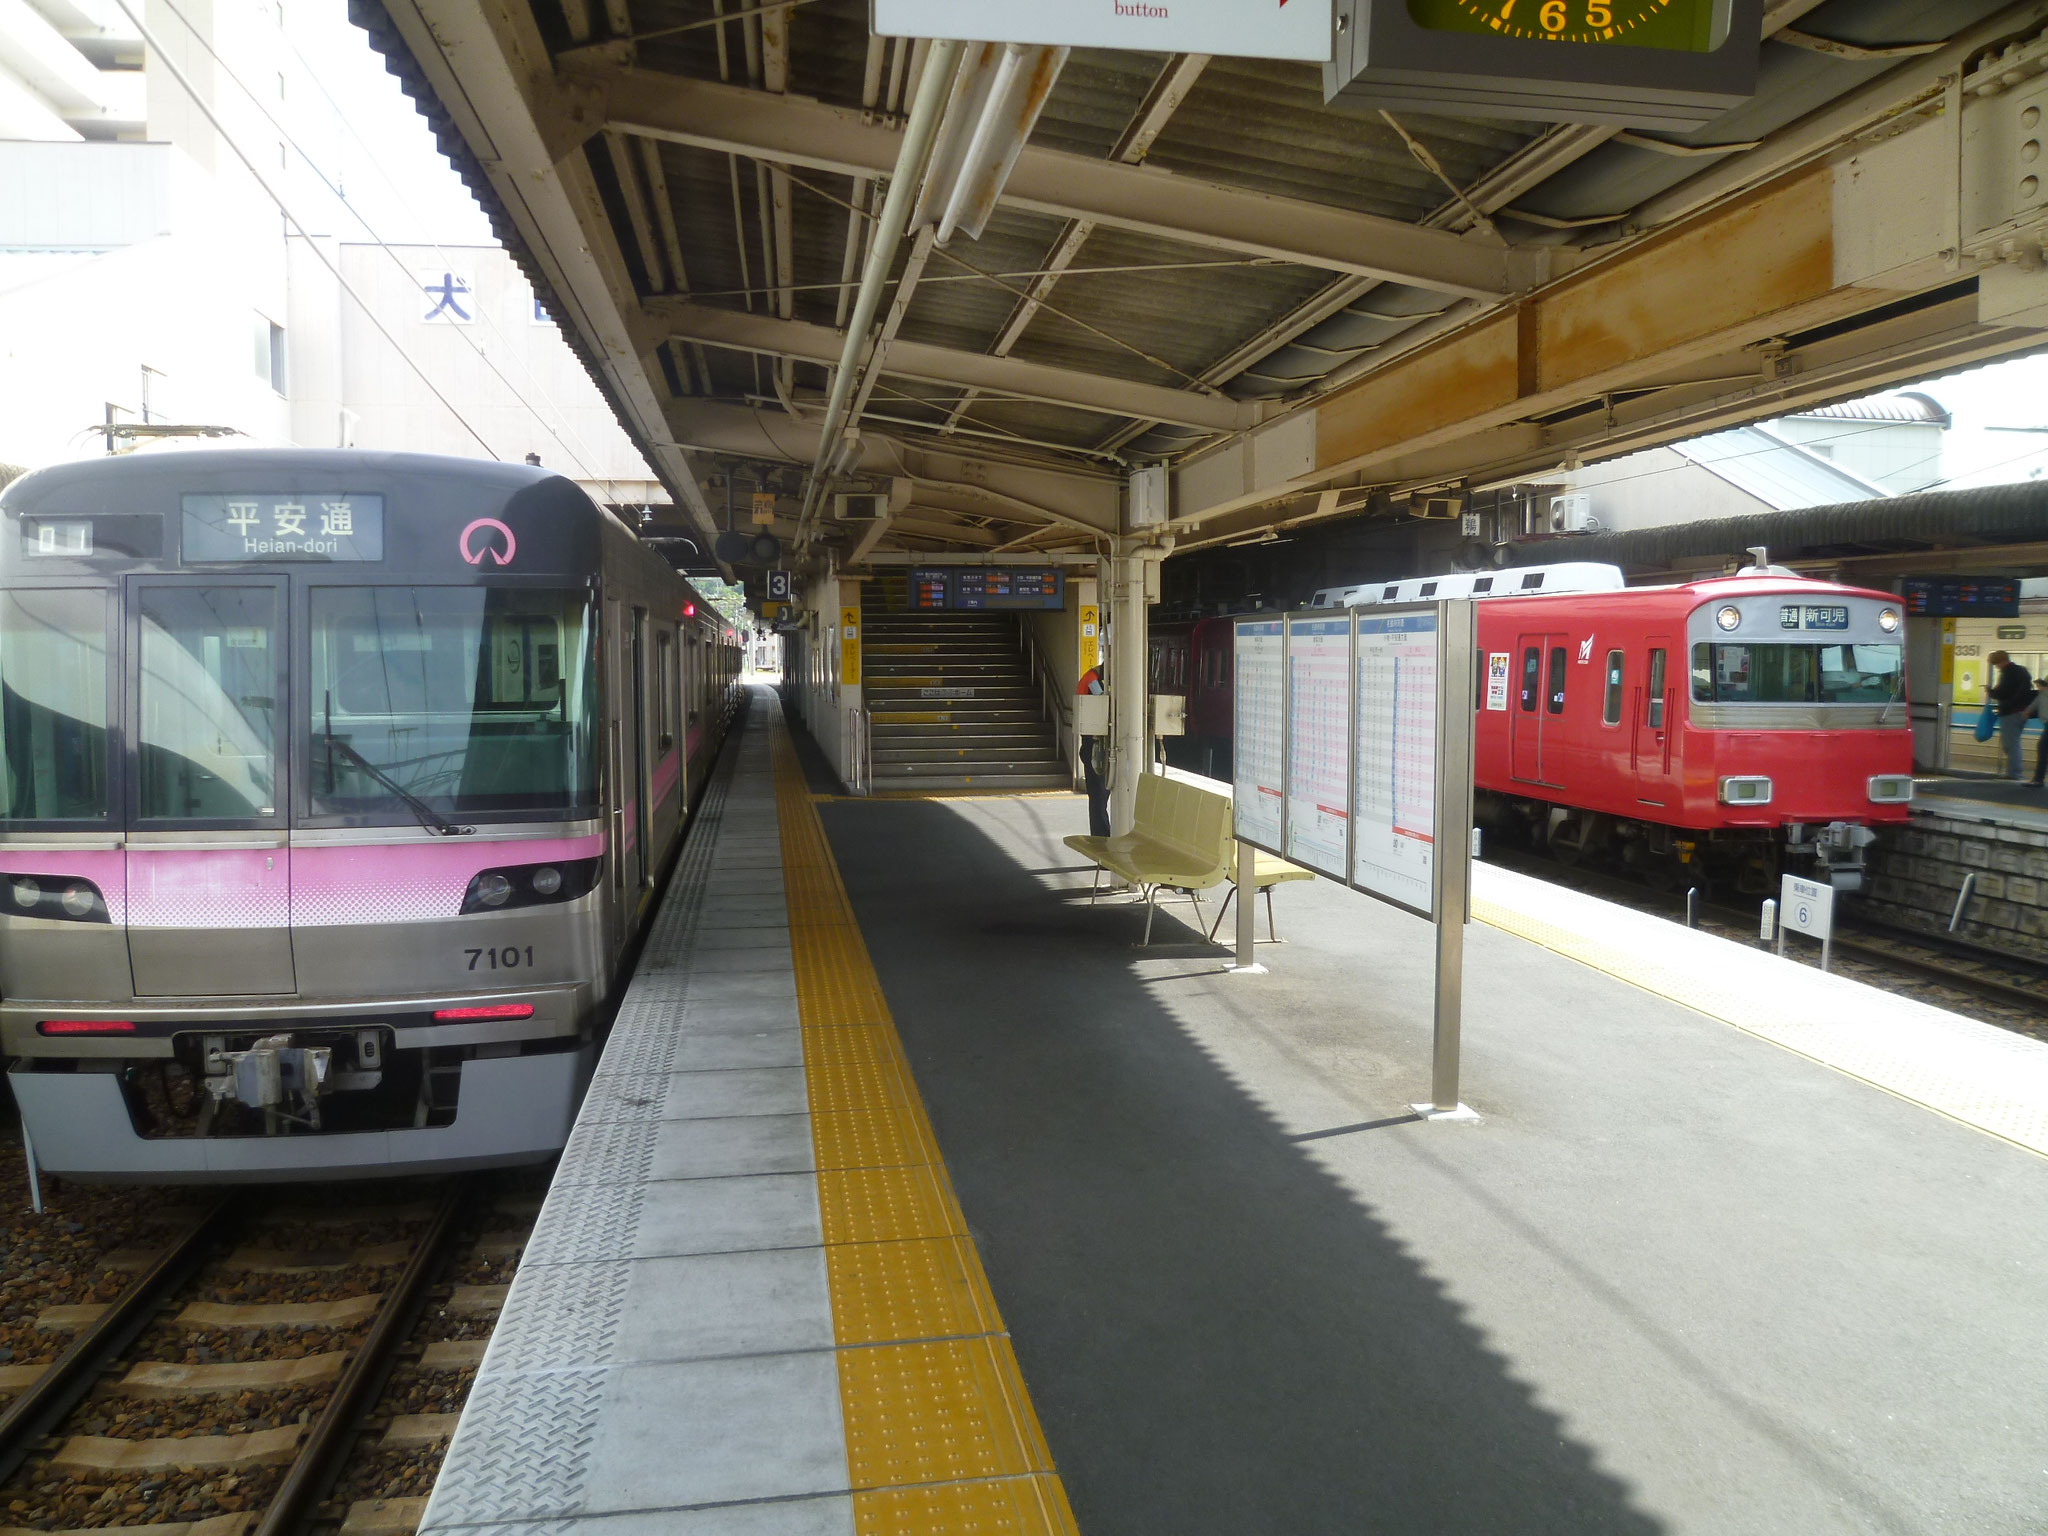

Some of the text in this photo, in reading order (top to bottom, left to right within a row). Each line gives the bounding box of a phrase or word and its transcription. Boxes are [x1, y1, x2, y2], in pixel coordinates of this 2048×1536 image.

[1113, 0, 1169, 19] button
[1539, 0, 1567, 32] 6
[1585, 0, 1612, 27] 5
[424, 273, 472, 321] 犬
[227, 502, 354, 536] 平安通
[244, 538, 338, 554] Heian-dori
[773, 575, 786, 595] 3
[1780, 608, 1845, 622] 普通 新可児
[1799, 907, 1807, 923] 6
[464, 945, 534, 971] 7101
